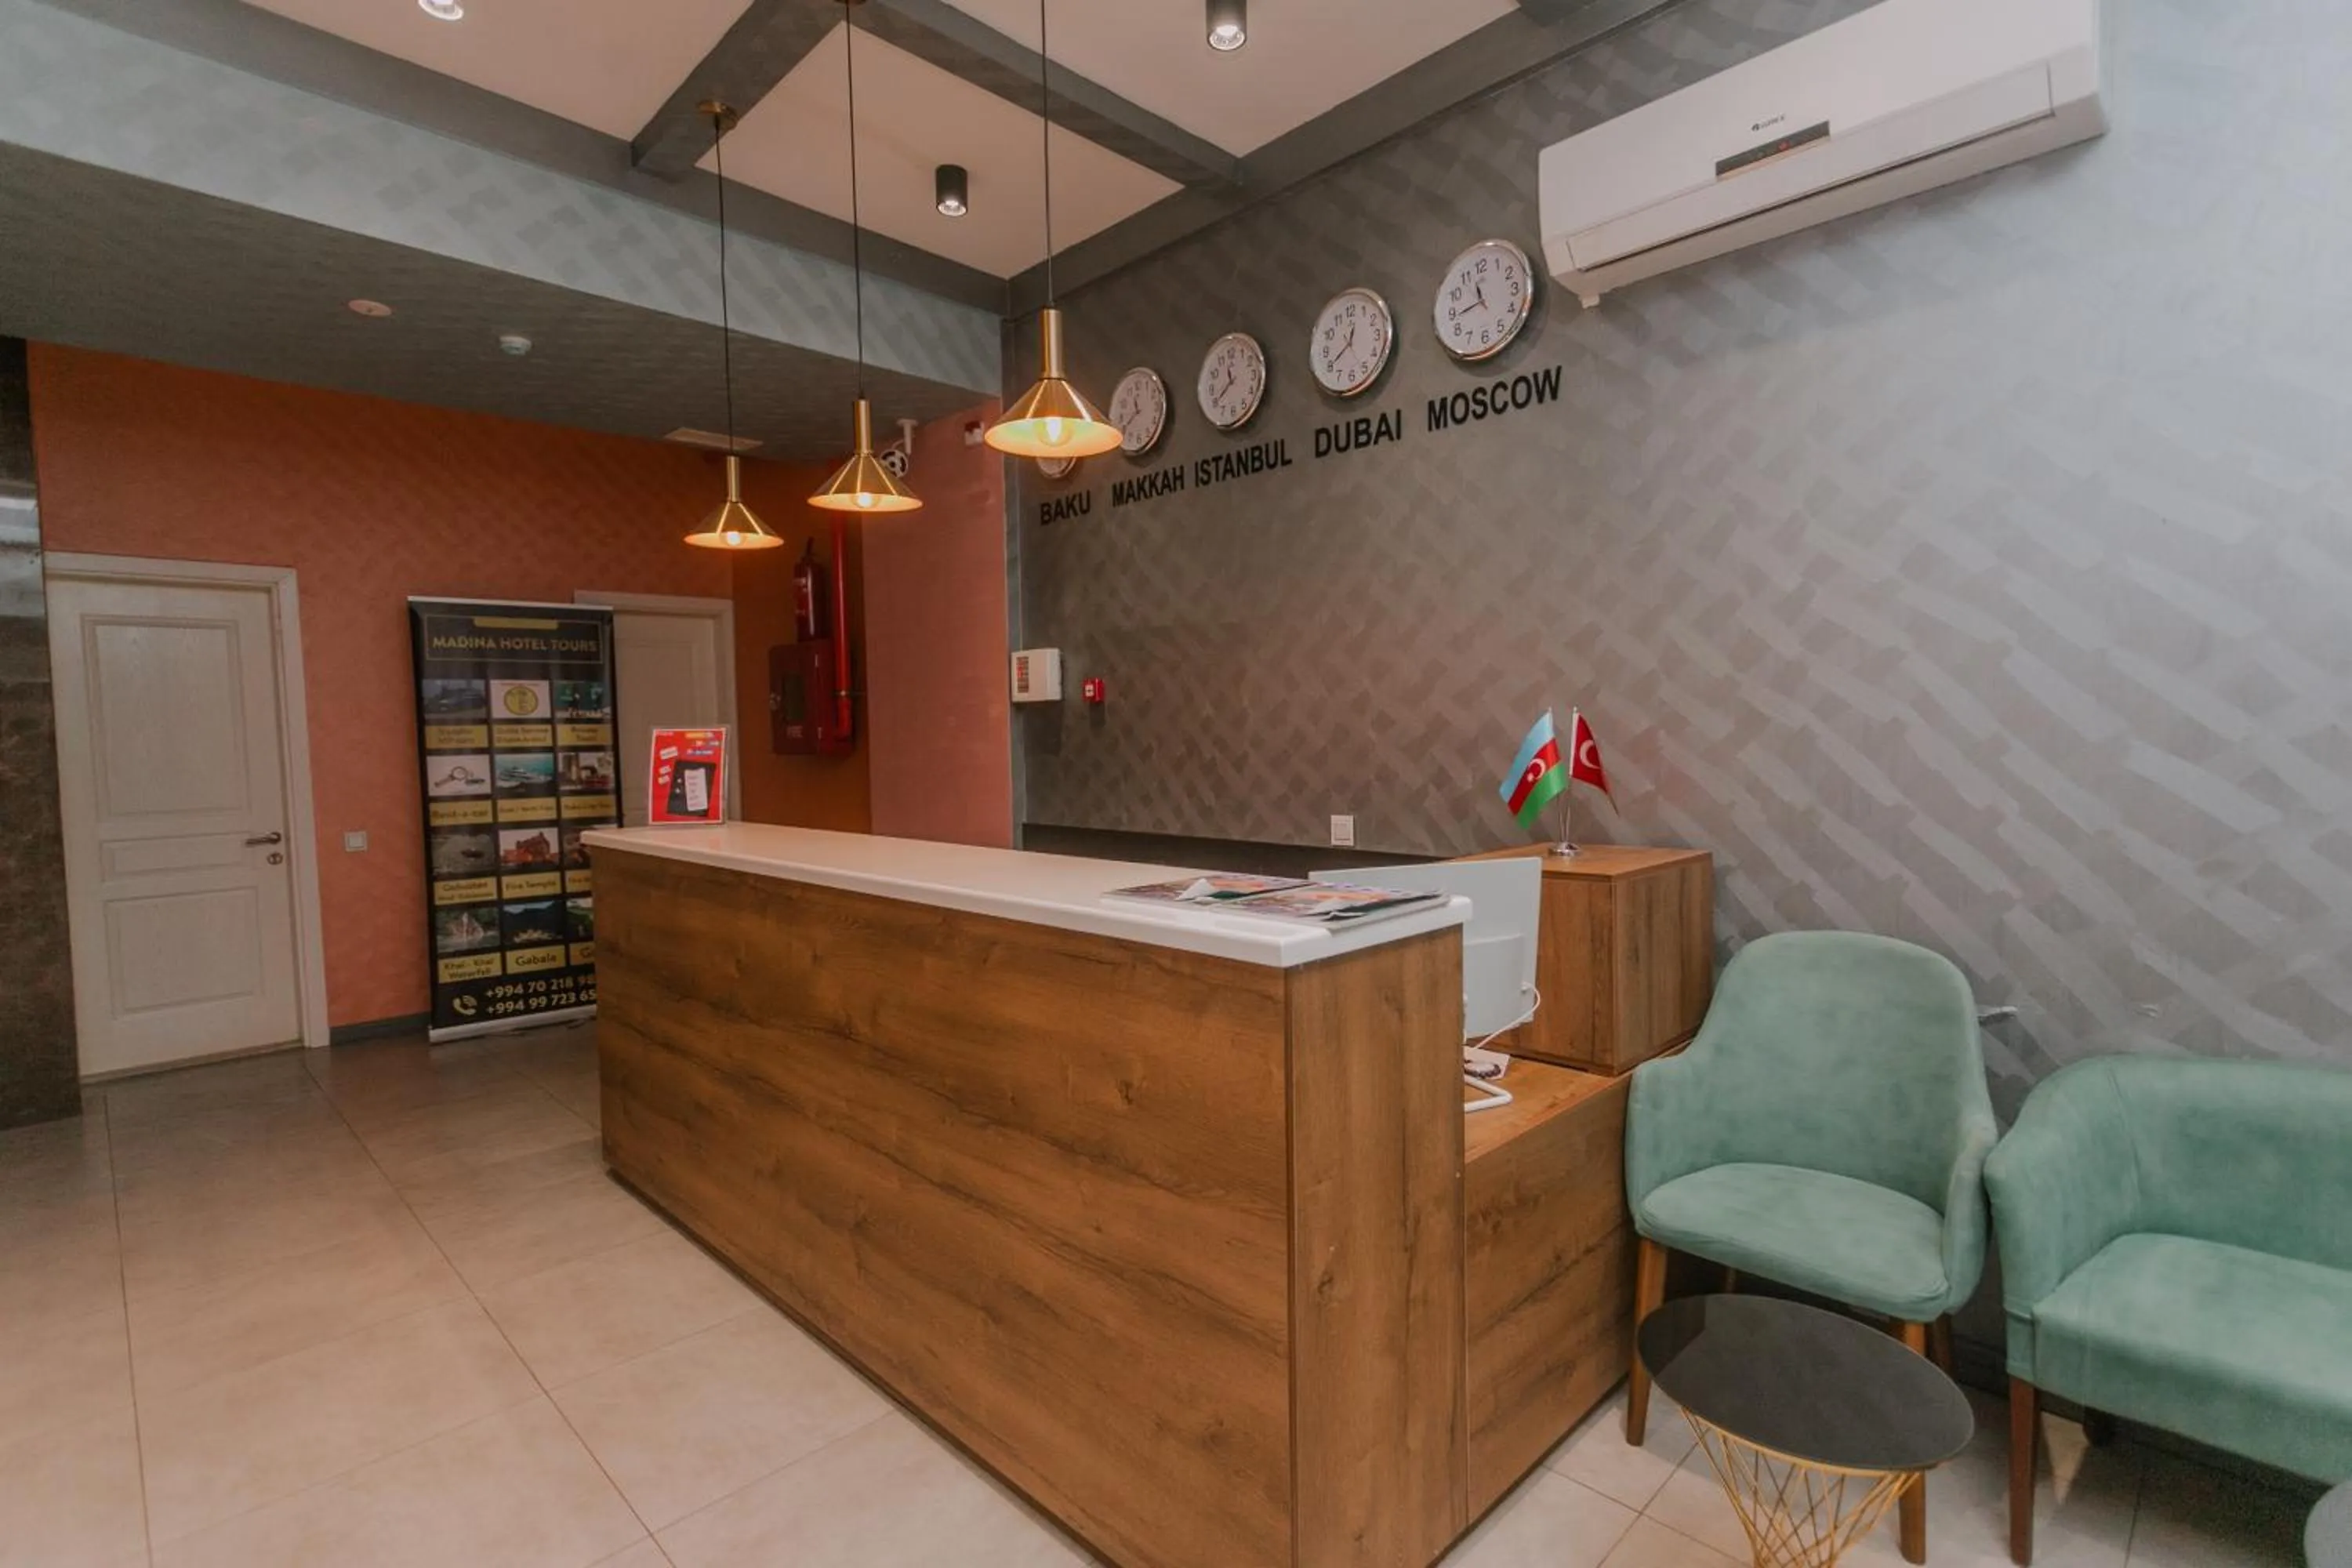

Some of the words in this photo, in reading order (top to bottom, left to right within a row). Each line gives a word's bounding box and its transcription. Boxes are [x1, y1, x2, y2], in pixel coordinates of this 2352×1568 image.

[1475, 259, 1487, 274] 12
[1495, 258, 1500, 270] 1
[1461, 270, 1472, 285] 11
[1505, 266, 1513, 281] 2
[1450, 287, 1461, 302] 10
[1511, 281, 1519, 296] 3
[1345, 303, 1355, 318] 12
[1362, 306, 1366, 318] 1
[1449, 307, 1456, 321] 9
[1508, 301, 1515, 314] 4
[1335, 314, 1342, 326] 11
[1370, 313, 1377, 326] 2
[1497, 319, 1504, 333] 5
[1323, 328, 1334, 340] 10
[1373, 328, 1380, 341] 3
[1454, 323, 1462, 336] 8
[1481, 330, 1490, 343] 6
[1465, 331, 1472, 344] 7
[1323, 346, 1329, 358] 9
[1370, 346, 1377, 357] 4
[1327, 360, 1334, 372] 8
[1361, 361, 1367, 374] 5
[1336, 369, 1342, 383] 7
[1348, 369, 1355, 383] 6
[1428, 365, 1562, 431] MOSCOW
[1315, 409, 1402, 458] DUBAI
[1195, 439, 1292, 487] ISTANBUL
[1112, 465, 1185, 507] MAKKAH
[1040, 490, 1091, 525] BAKU
[433, 637, 496, 649] MADINA
[500, 639, 547, 651] HOTEL
[550, 640, 597, 652] TOURS
[485, 982, 524, 998] +994
[528, 980, 546, 993] 70
[486, 998, 524, 1014] +994
[529, 995, 547, 1010] 99
[551, 991, 576, 1007] 723
